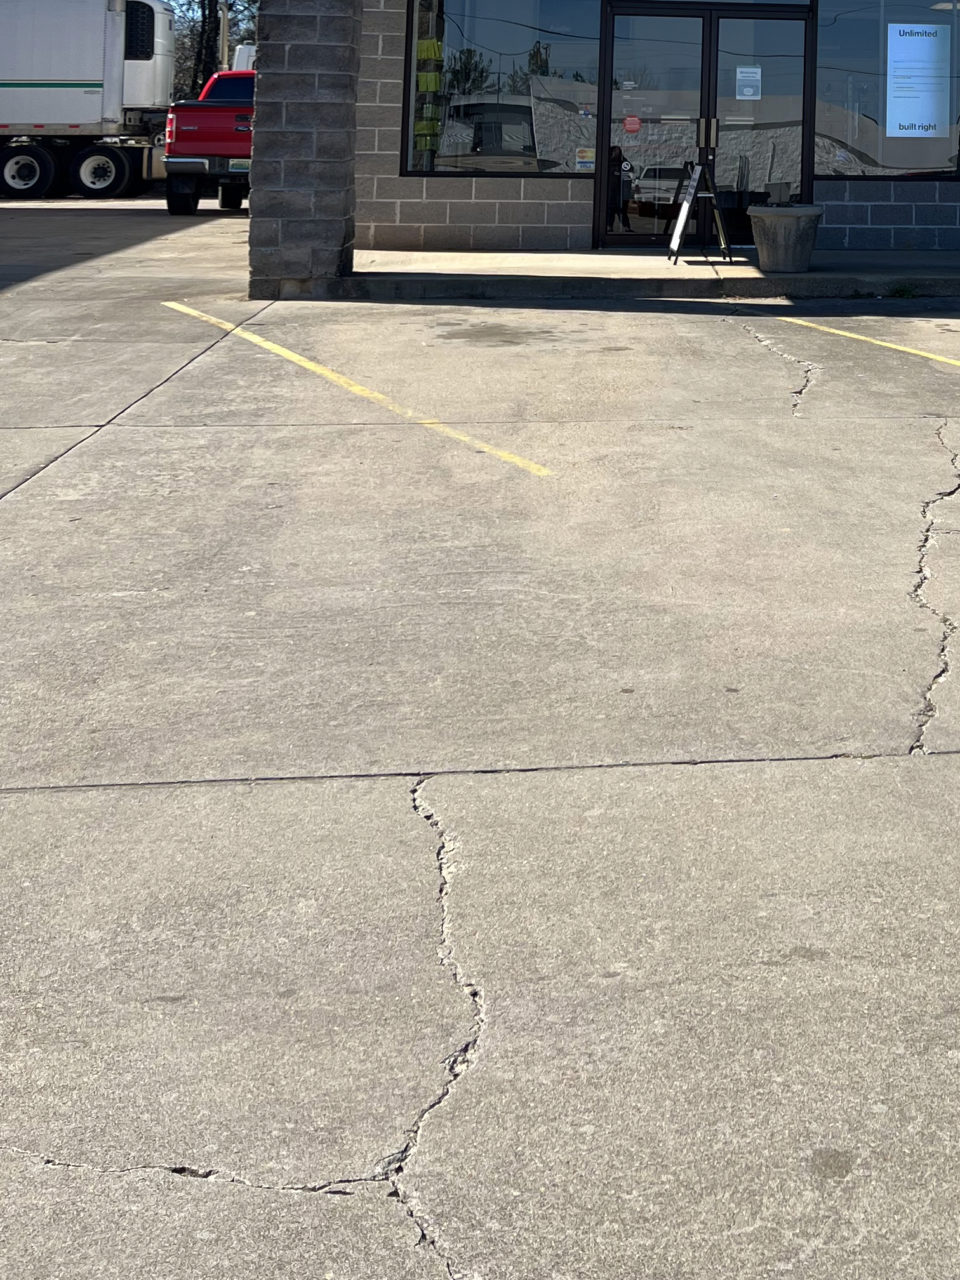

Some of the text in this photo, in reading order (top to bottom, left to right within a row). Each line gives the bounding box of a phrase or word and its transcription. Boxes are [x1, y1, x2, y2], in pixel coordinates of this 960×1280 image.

[899, 29, 937, 38] Unlimited
[899, 123, 937, 132] built right
